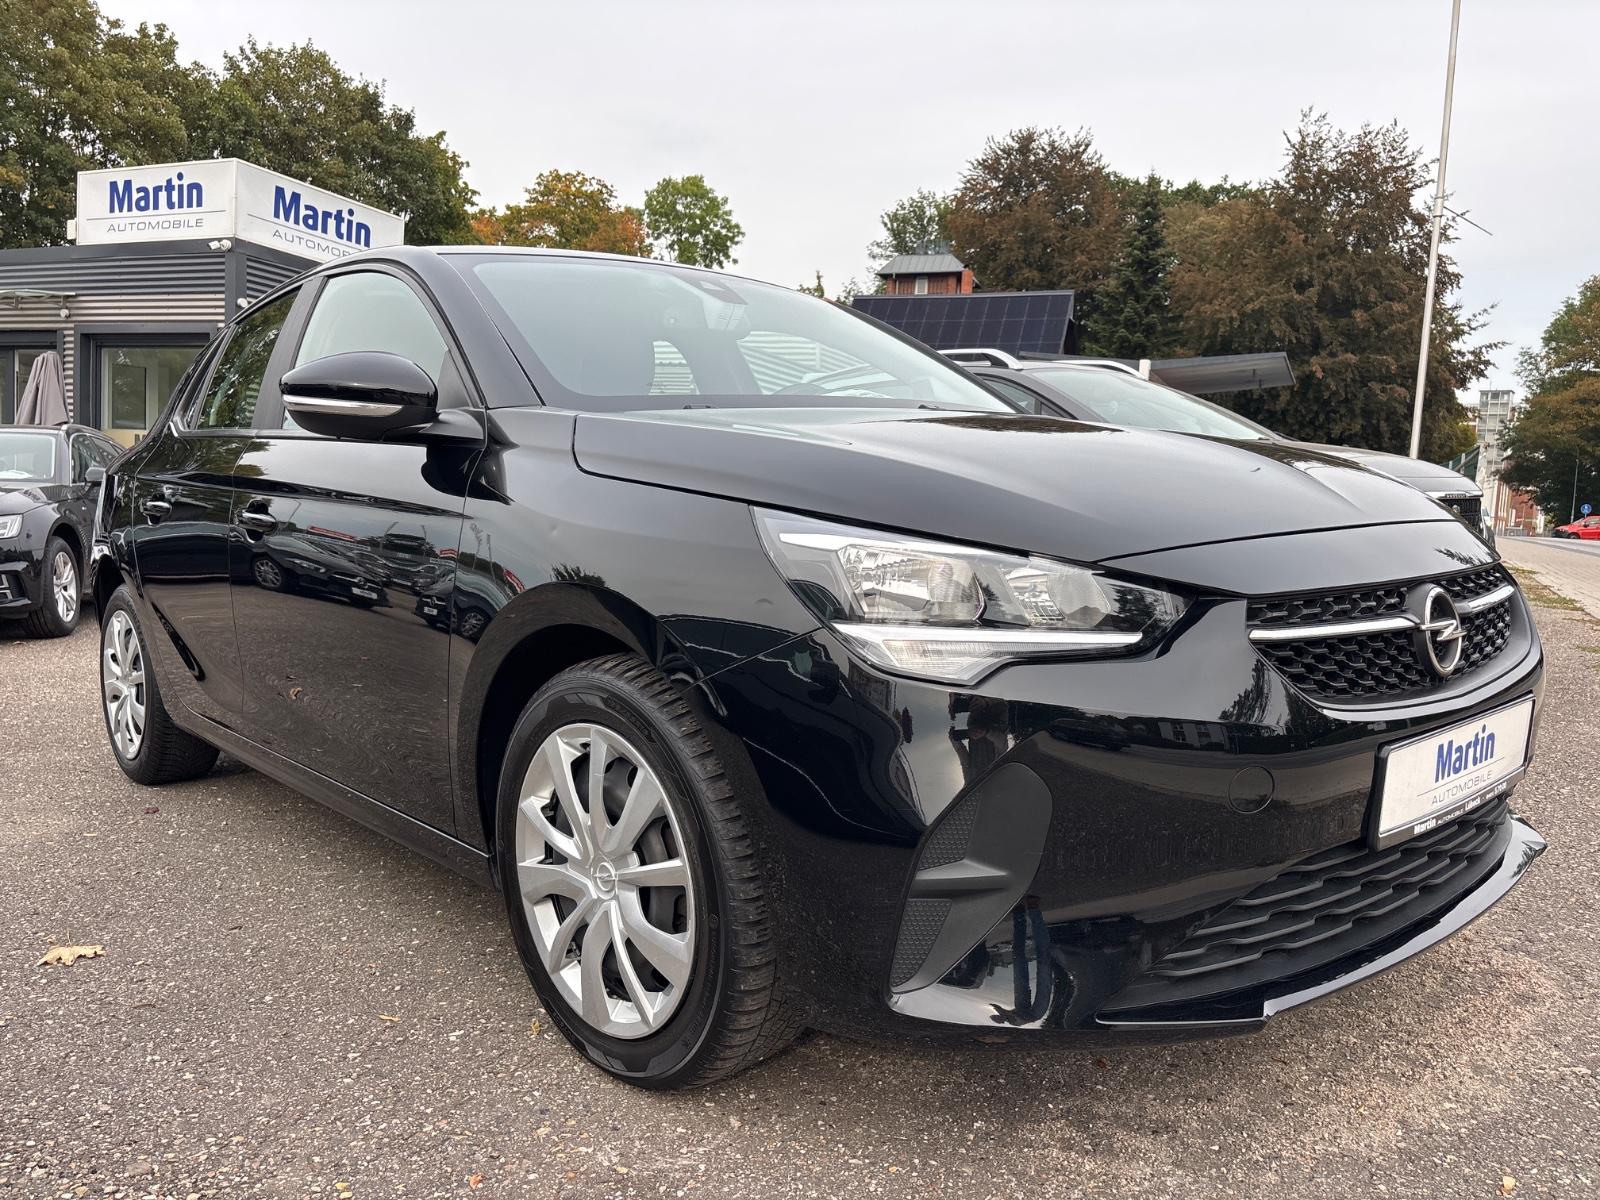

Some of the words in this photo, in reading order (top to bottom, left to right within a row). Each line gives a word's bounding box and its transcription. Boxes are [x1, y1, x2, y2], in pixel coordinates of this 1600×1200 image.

[109, 172, 203, 213] Martin
[107, 218, 204, 233] AUTOMOBILE
[273, 185, 371, 248] Martin
[1434, 724, 1495, 783] Martin
[1431, 770, 1493, 805] AUTOMOBILE
[1414, 818, 1436, 835] Martin
